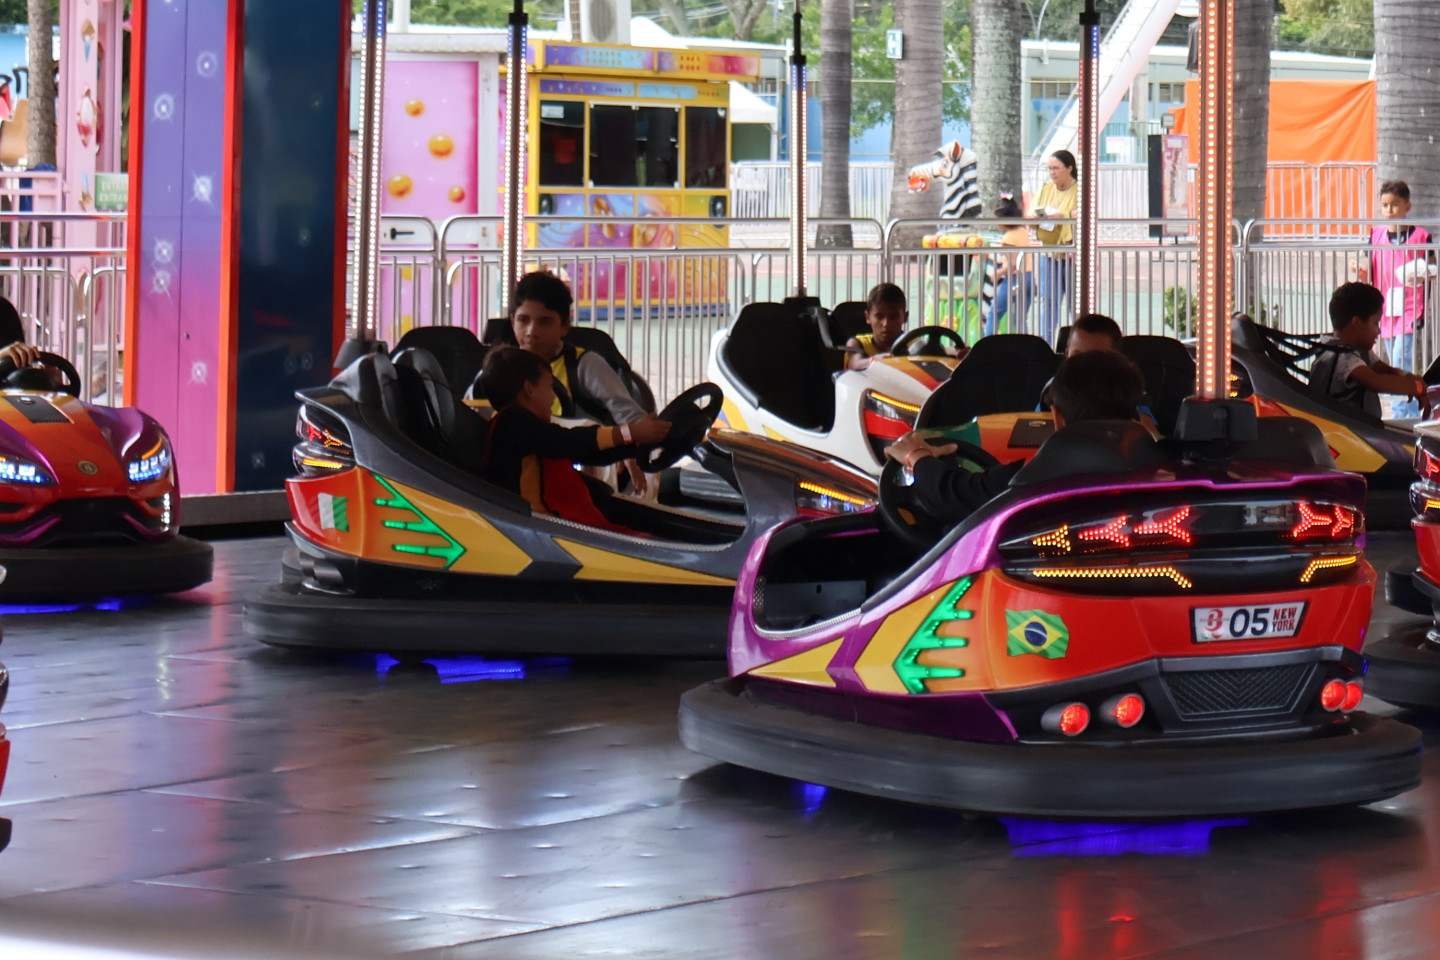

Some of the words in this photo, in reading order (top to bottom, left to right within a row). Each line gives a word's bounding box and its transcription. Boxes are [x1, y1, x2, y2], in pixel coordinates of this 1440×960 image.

[1273, 607, 1297, 620] NEW
[1229, 607, 1270, 637] 05
[1272, 620, 1295, 632] YORK
